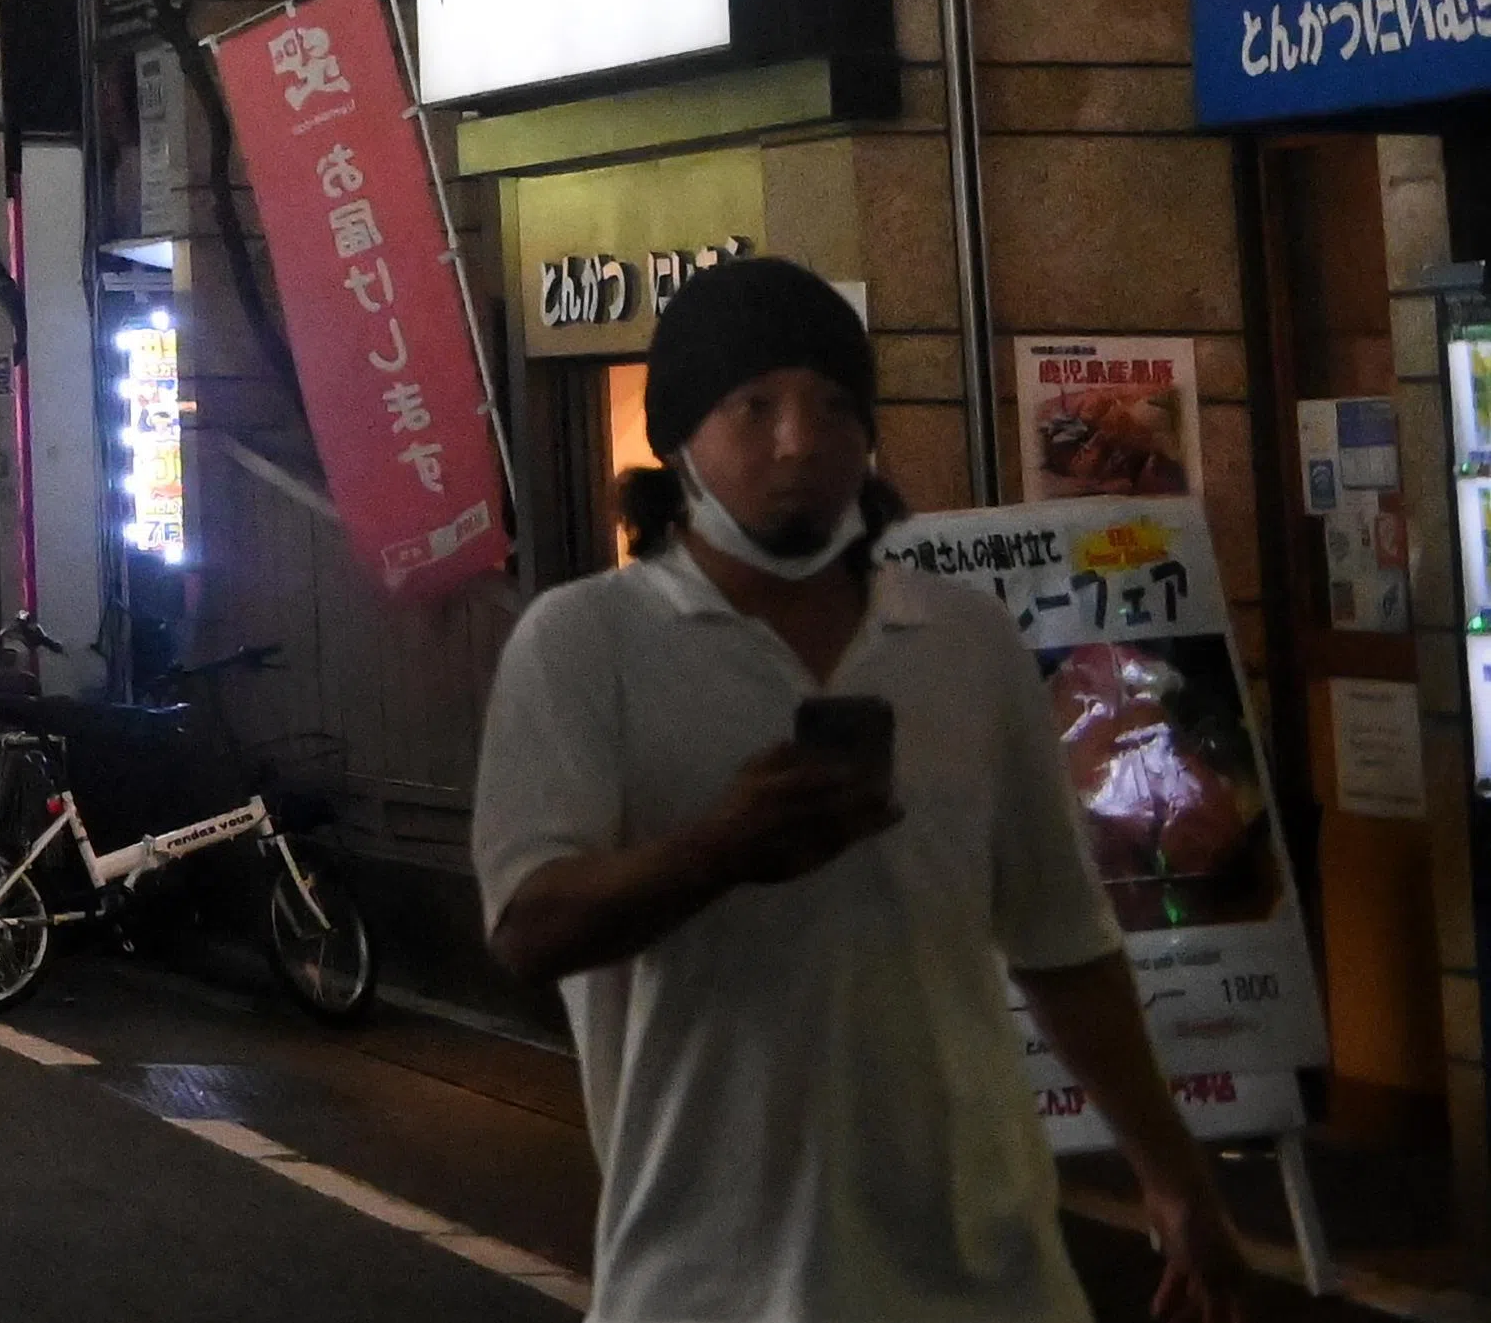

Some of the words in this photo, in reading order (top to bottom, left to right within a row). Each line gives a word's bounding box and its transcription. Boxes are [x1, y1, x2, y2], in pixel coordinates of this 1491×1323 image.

[315, 145, 446, 496] お届けします
[538, 259, 629, 328] とんかつ
[1038, 358, 1176, 385] 鹿児島産黒豚
[165, 823, 218, 850] rendez
[218, 811, 255, 833] vous
